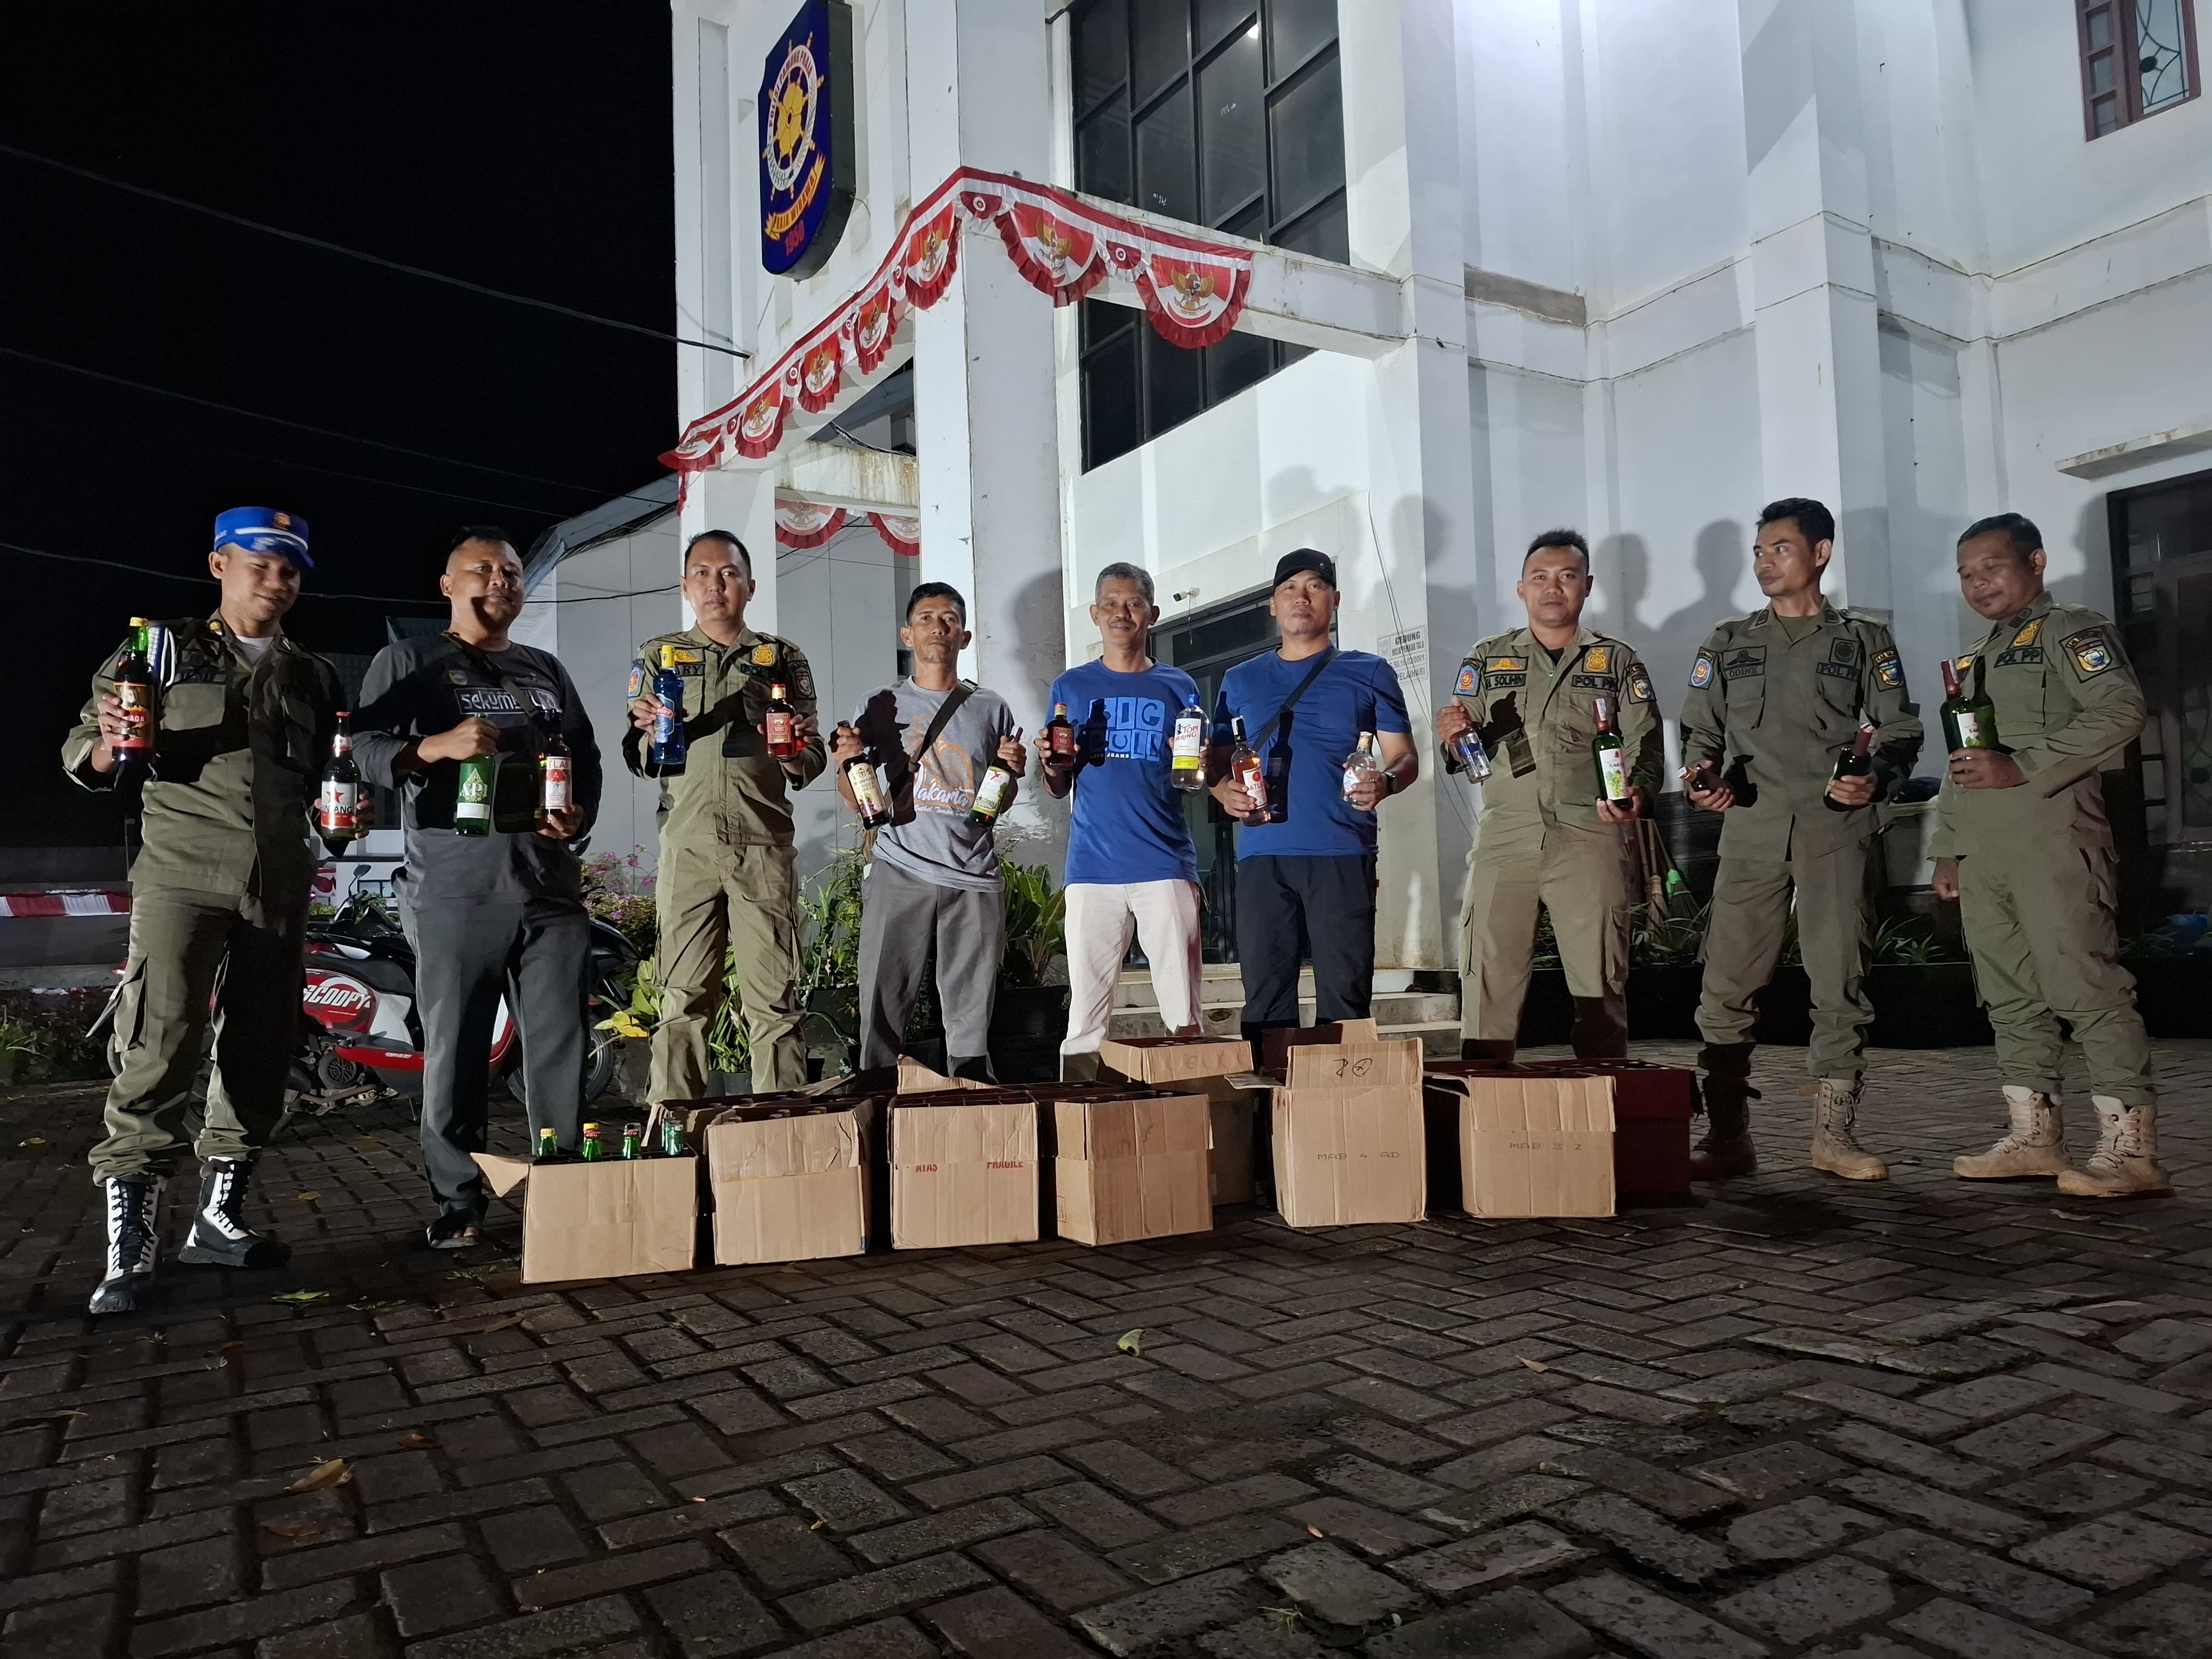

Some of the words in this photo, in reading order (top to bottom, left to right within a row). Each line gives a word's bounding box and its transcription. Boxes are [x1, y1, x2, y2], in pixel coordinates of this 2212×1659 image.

[769, 83, 780, 127] POLISI
[1395, 631, 1420, 645] GEDUNG
[2021, 649, 2041, 661] PP
[1821, 664, 1843, 676] POL
[1574, 677, 1598, 687] POL
[1182, 725, 1198, 734] TOPI
[1174, 732, 1197, 743] MIRING
[303, 985, 371, 1010] SCOOPY
